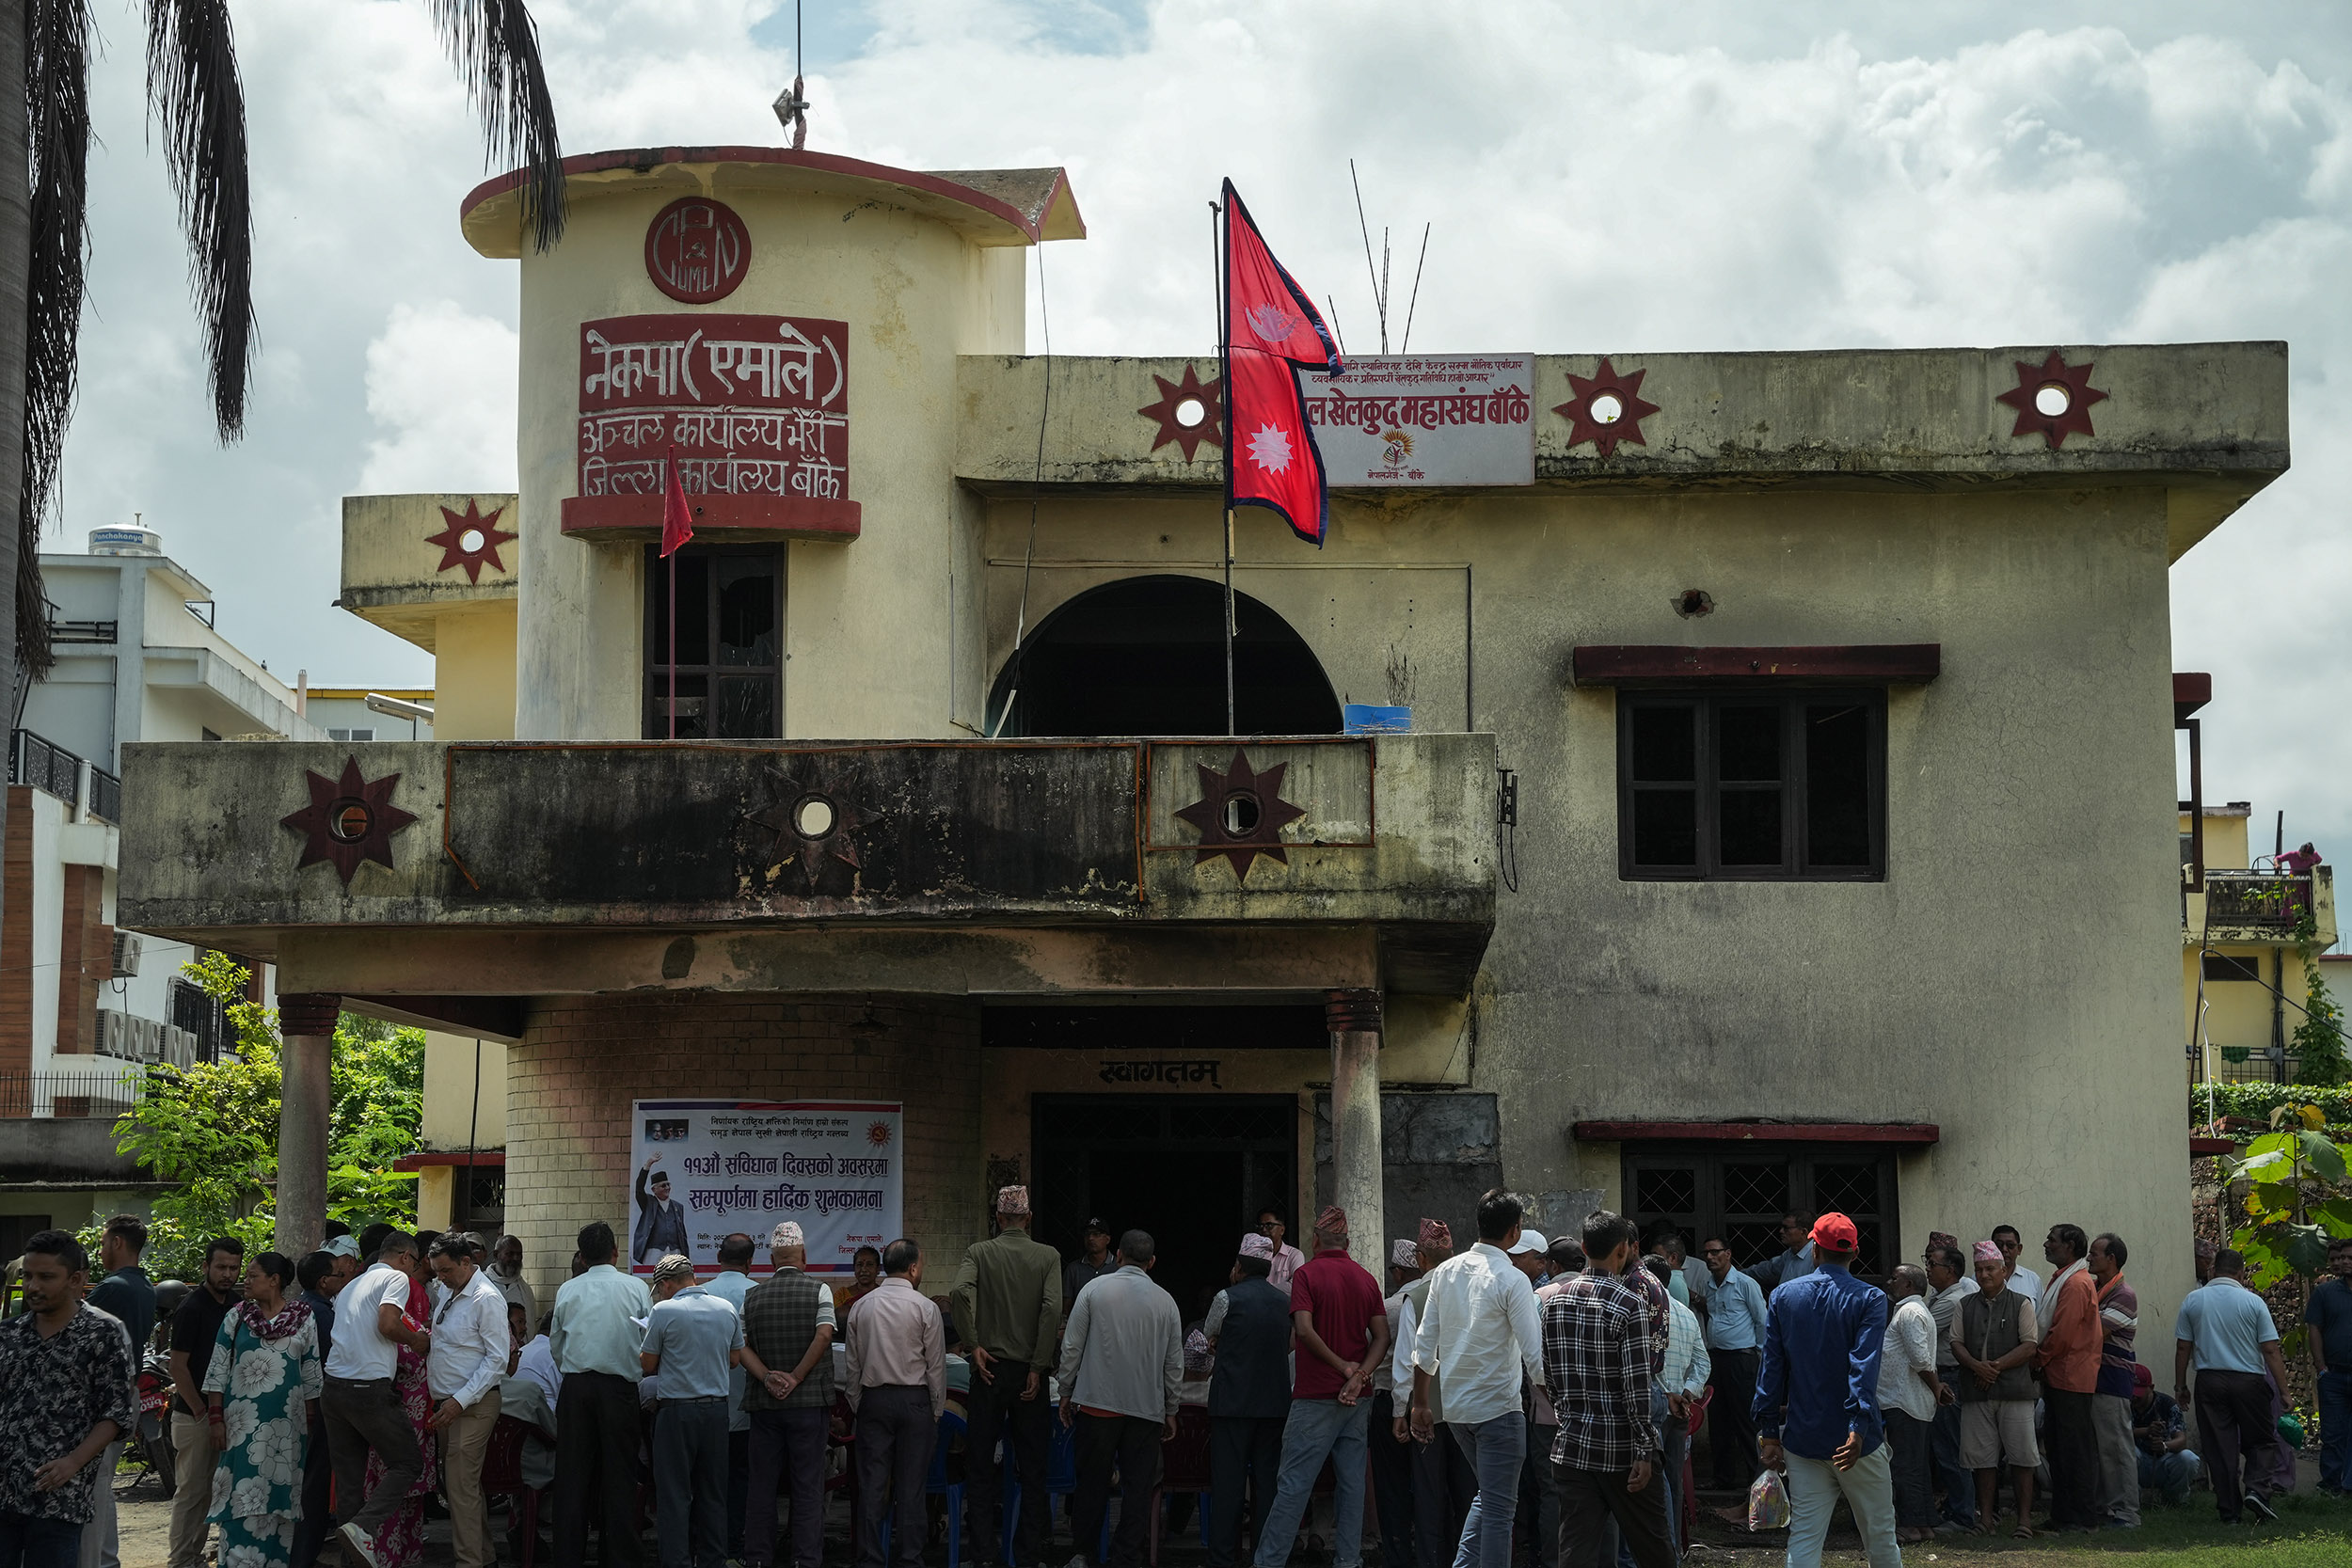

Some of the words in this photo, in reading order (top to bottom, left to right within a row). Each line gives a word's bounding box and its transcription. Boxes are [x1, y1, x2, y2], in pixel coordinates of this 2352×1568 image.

[1327, 388, 1400, 436] खेलकुद
[1400, 387, 1487, 431] महासंघ
[1487, 384, 1530, 424] बाँके
[791, 454, 847, 499] बाँके
[724, 1150, 779, 1176] संविधान
[782, 1151, 834, 1176] दिवसको
[837, 1158, 889, 1176] अवसरमा
[689, 1183, 758, 1215] सम्पूर्णमा
[762, 1182, 811, 1211] हार्दिक
[814, 1189, 883, 1214] शुभकामना
